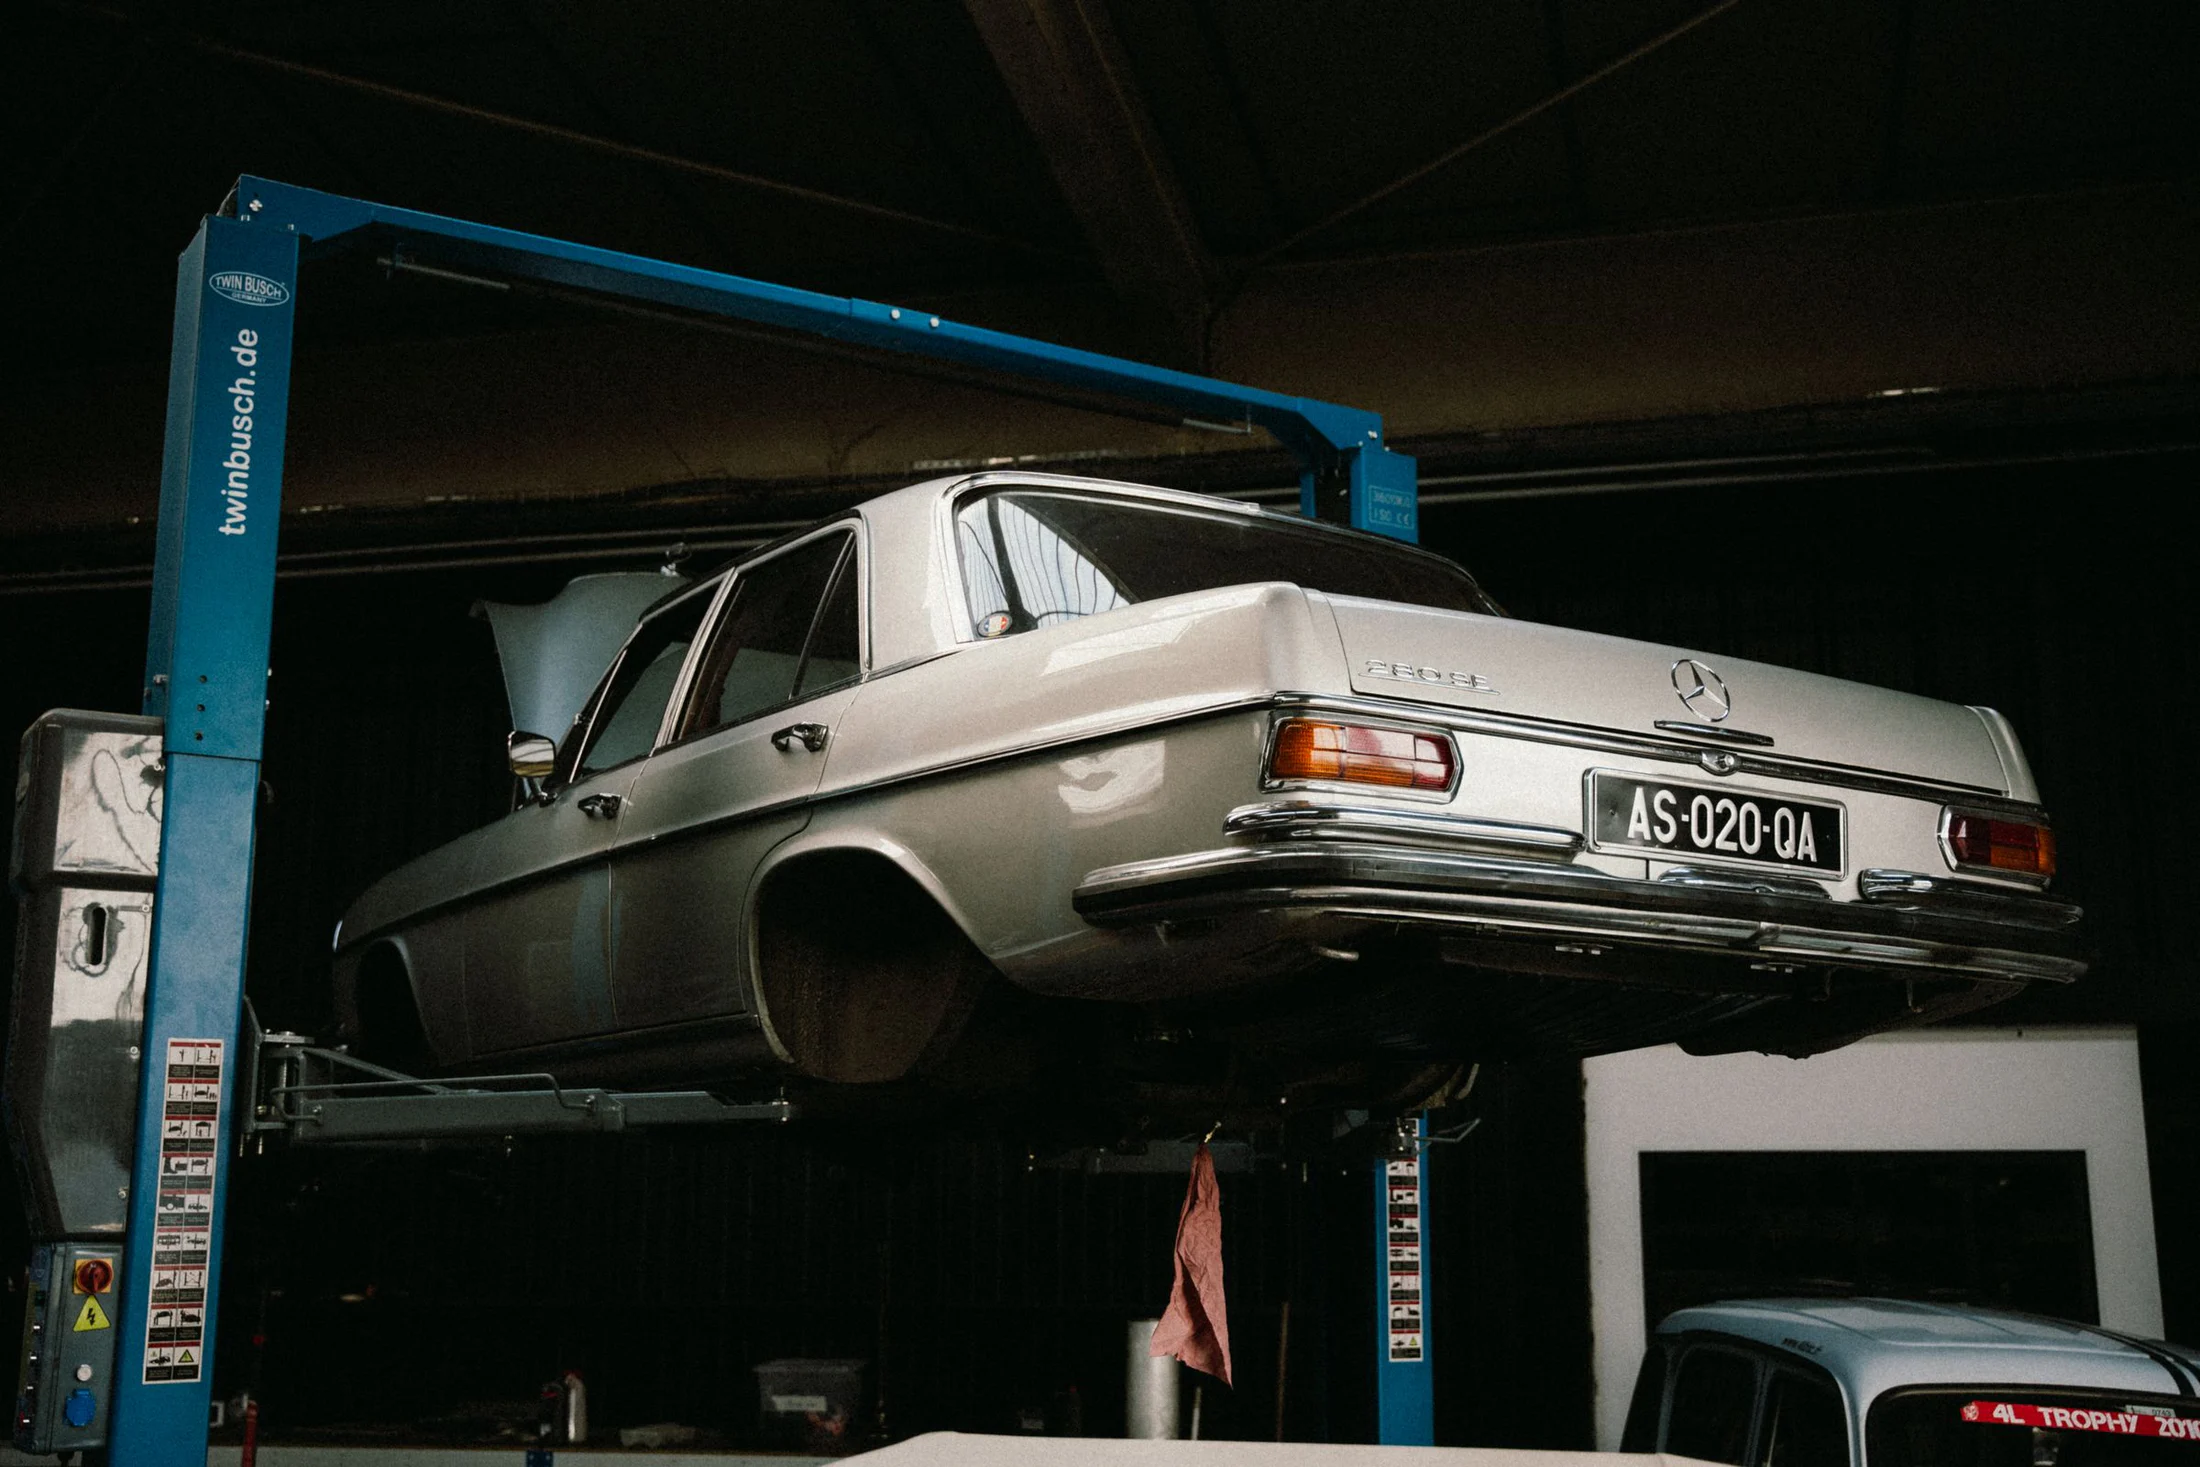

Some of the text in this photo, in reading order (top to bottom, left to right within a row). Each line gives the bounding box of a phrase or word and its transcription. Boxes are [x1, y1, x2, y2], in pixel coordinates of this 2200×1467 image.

[215, 275, 282, 298] TWIN BUSCH
[231, 292, 267, 304] GERMANY
[218, 328, 258, 536] twinbusch.de
[1365, 659, 1490, 690] 280 SE
[1627, 786, 1818, 863] AS-020-QA
[1992, 1403, 2025, 1424] 4L
[2037, 1406, 2138, 1434] TROPHY
